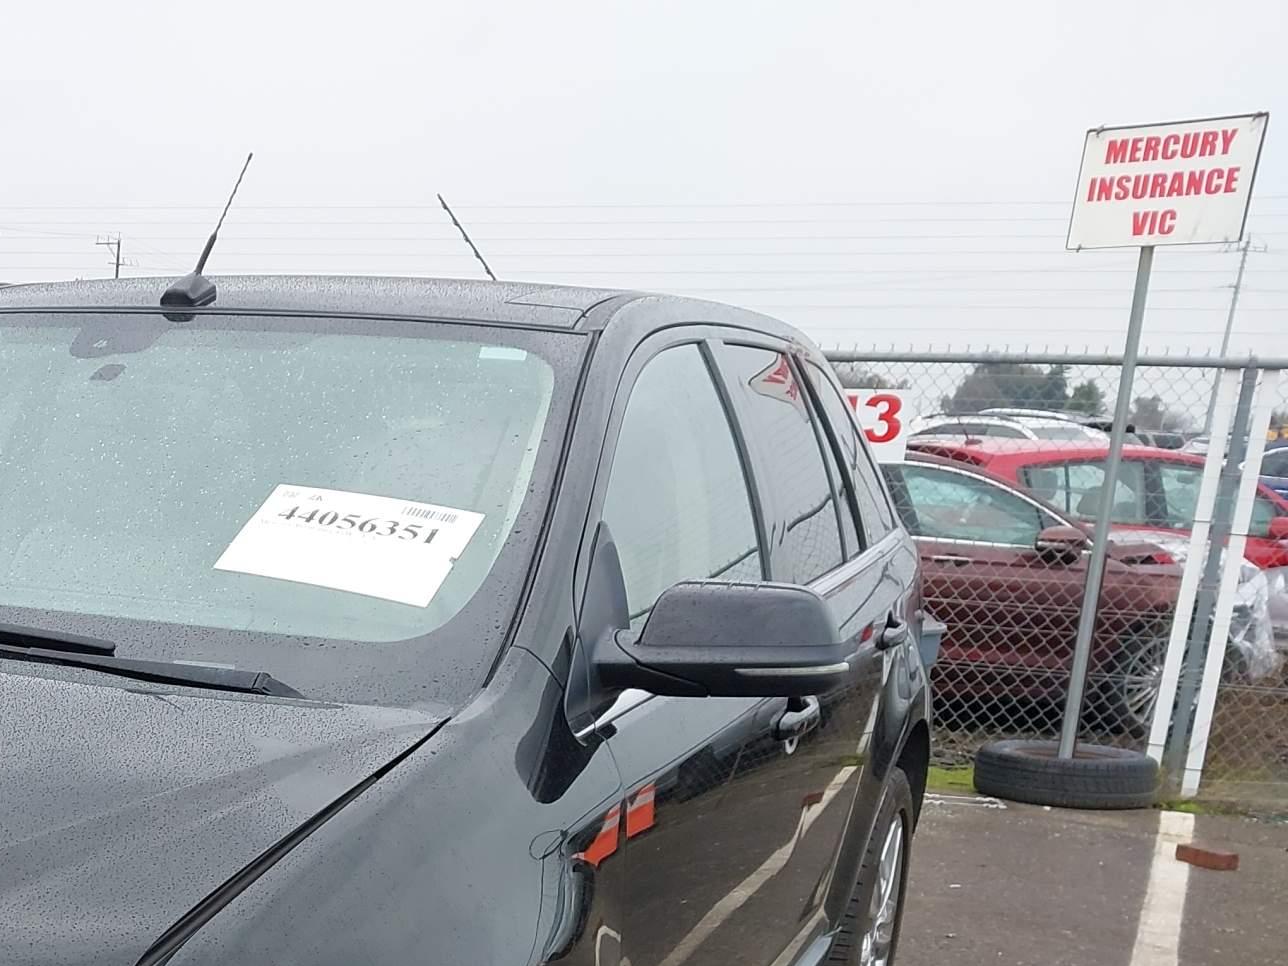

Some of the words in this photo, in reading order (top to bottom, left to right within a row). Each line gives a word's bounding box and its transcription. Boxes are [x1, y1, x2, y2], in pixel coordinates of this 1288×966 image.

[1104, 128, 1239, 165] MERCURY
[1086, 167, 1241, 202] INSURANCE
[1132, 209, 1177, 236] VIC
[277, 505, 440, 545] 44056351
